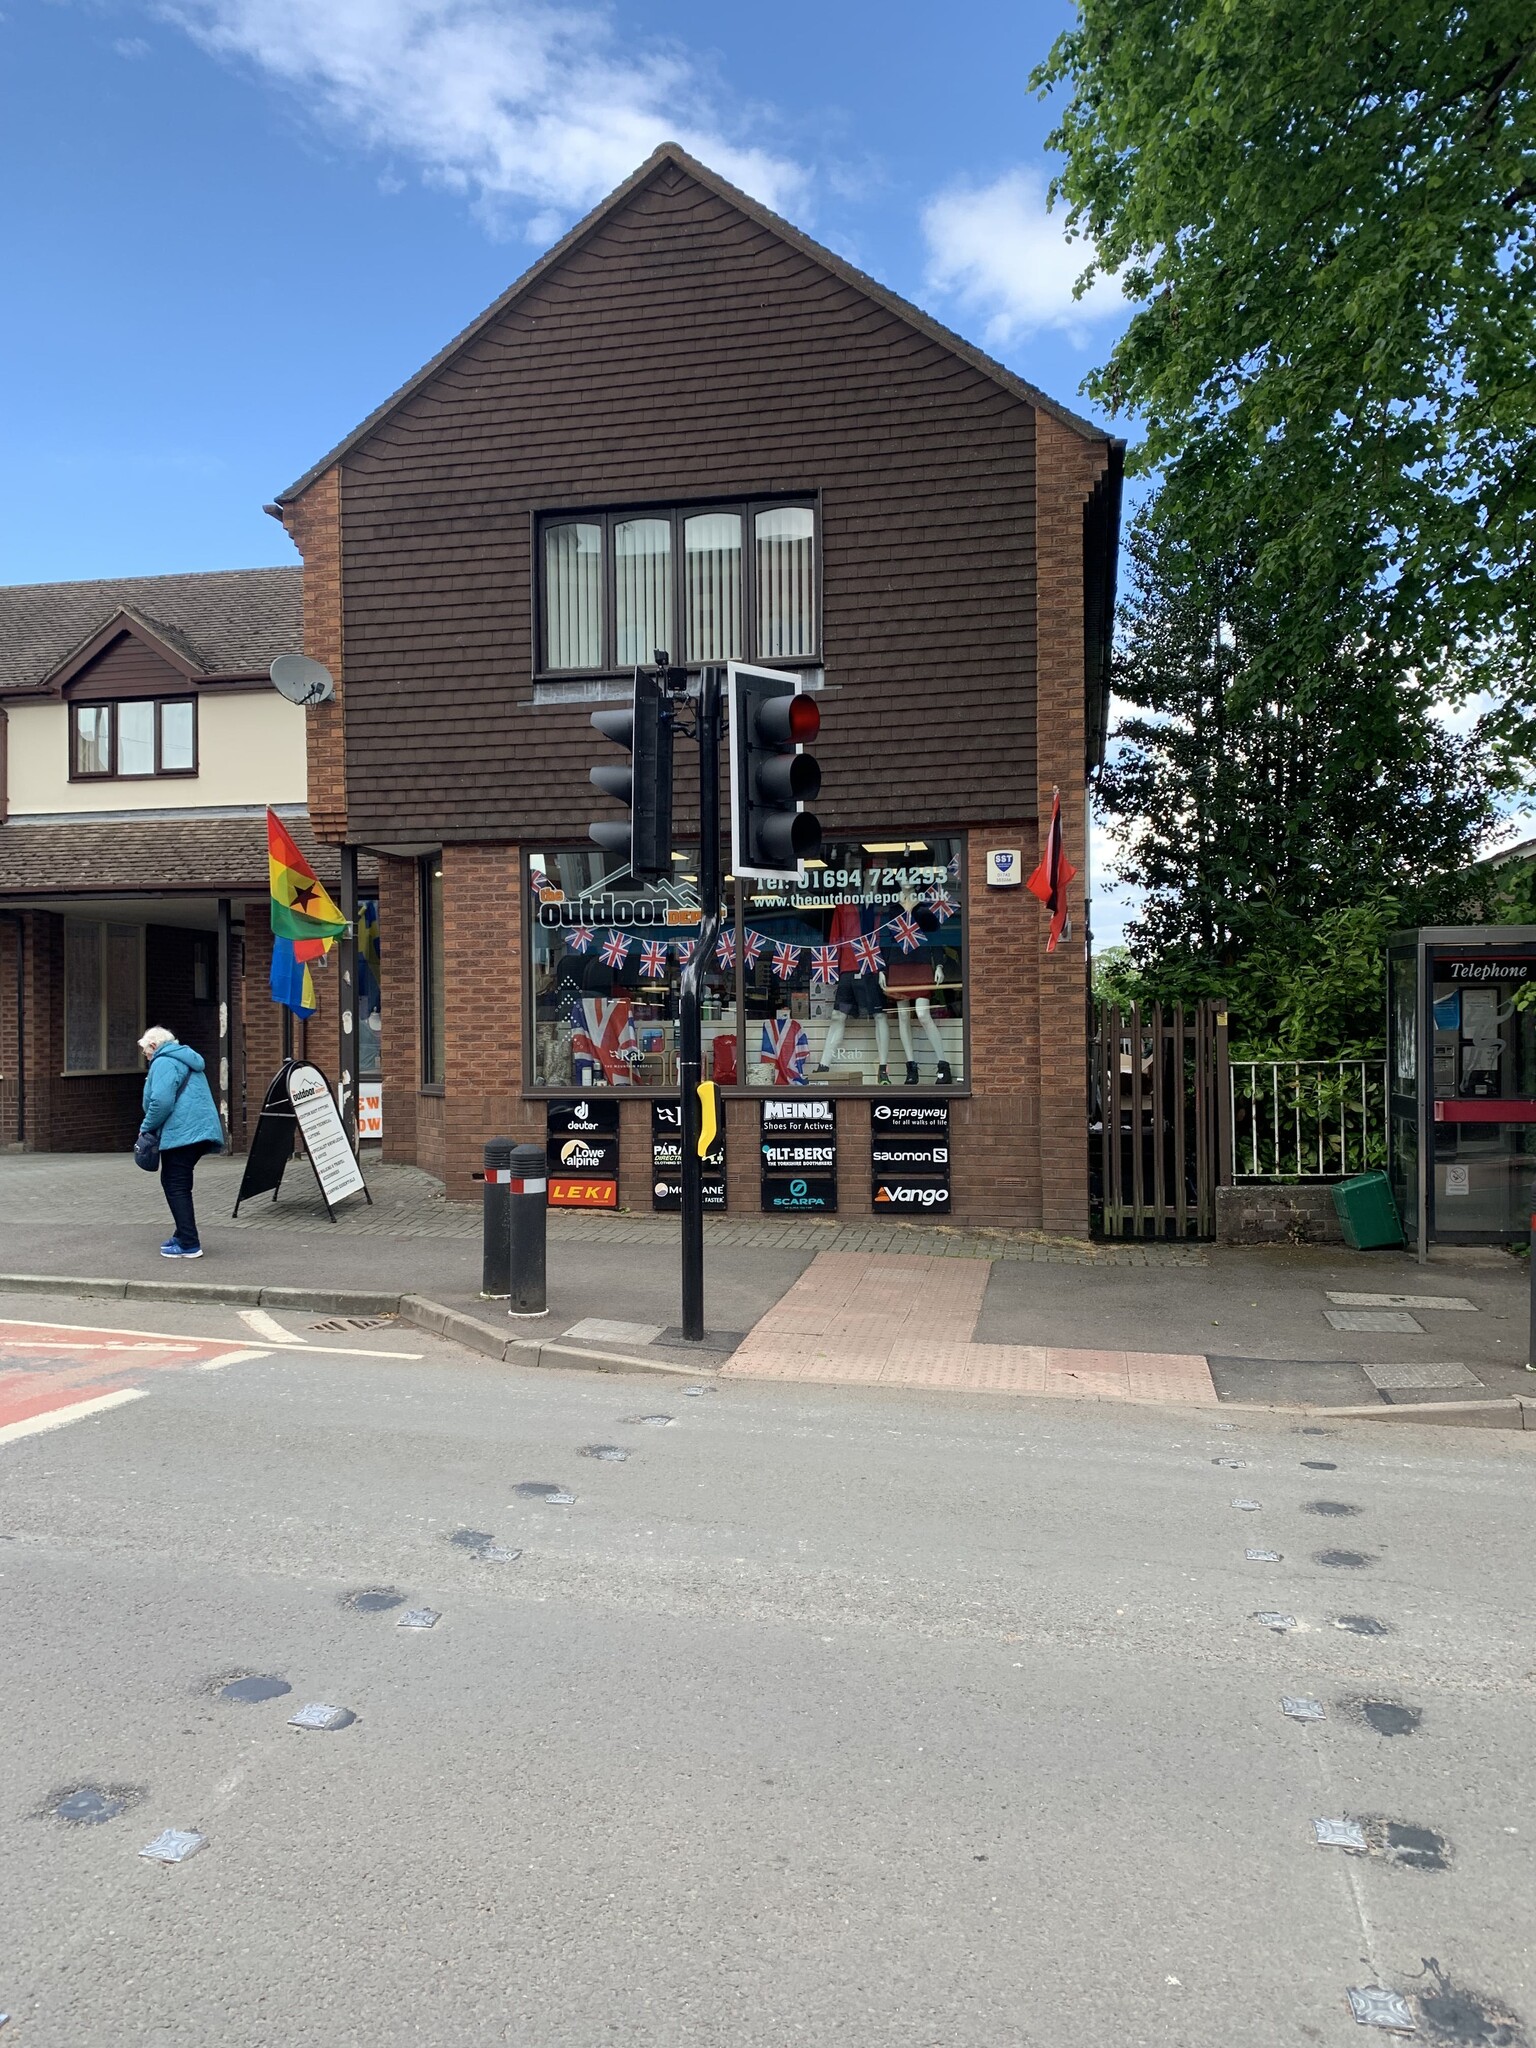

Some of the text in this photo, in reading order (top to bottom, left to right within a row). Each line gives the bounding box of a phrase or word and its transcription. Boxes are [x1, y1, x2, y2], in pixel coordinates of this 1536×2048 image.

[995, 855, 1012, 863] SST
[754, 866, 948, 890] Tel: 01694 724293
[539, 887, 565, 903] the
[754, 889, 949, 908] www.theoutdoordepot.co.uk
[540, 893, 668, 929] outdoor
[1450, 962, 1528, 981] Telephone
[620, 1049, 645, 1061] Rab
[837, 1047, 863, 1060] Rab
[292, 1087, 315, 1102] outdoor
[359, 1096, 380, 1111] EW
[763, 1100, 834, 1121] MEINDL
[892, 1108, 948, 1120] sprayway
[359, 1117, 381, 1133] OW
[567, 1120, 599, 1130] deuter
[763, 1121, 834, 1130] Shoes For Actives
[576, 1146, 605, 1158] Lowe
[653, 1142, 682, 1156] PÁR
[766, 1147, 833, 1161] ALT-BERG
[566, 1155, 600, 1168] alpine
[552, 1185, 612, 1199] LEKI
[669, 1186, 724, 1195] MANE
[883, 1186, 949, 1206] Vango
[773, 1198, 825, 1206] SCARPA
